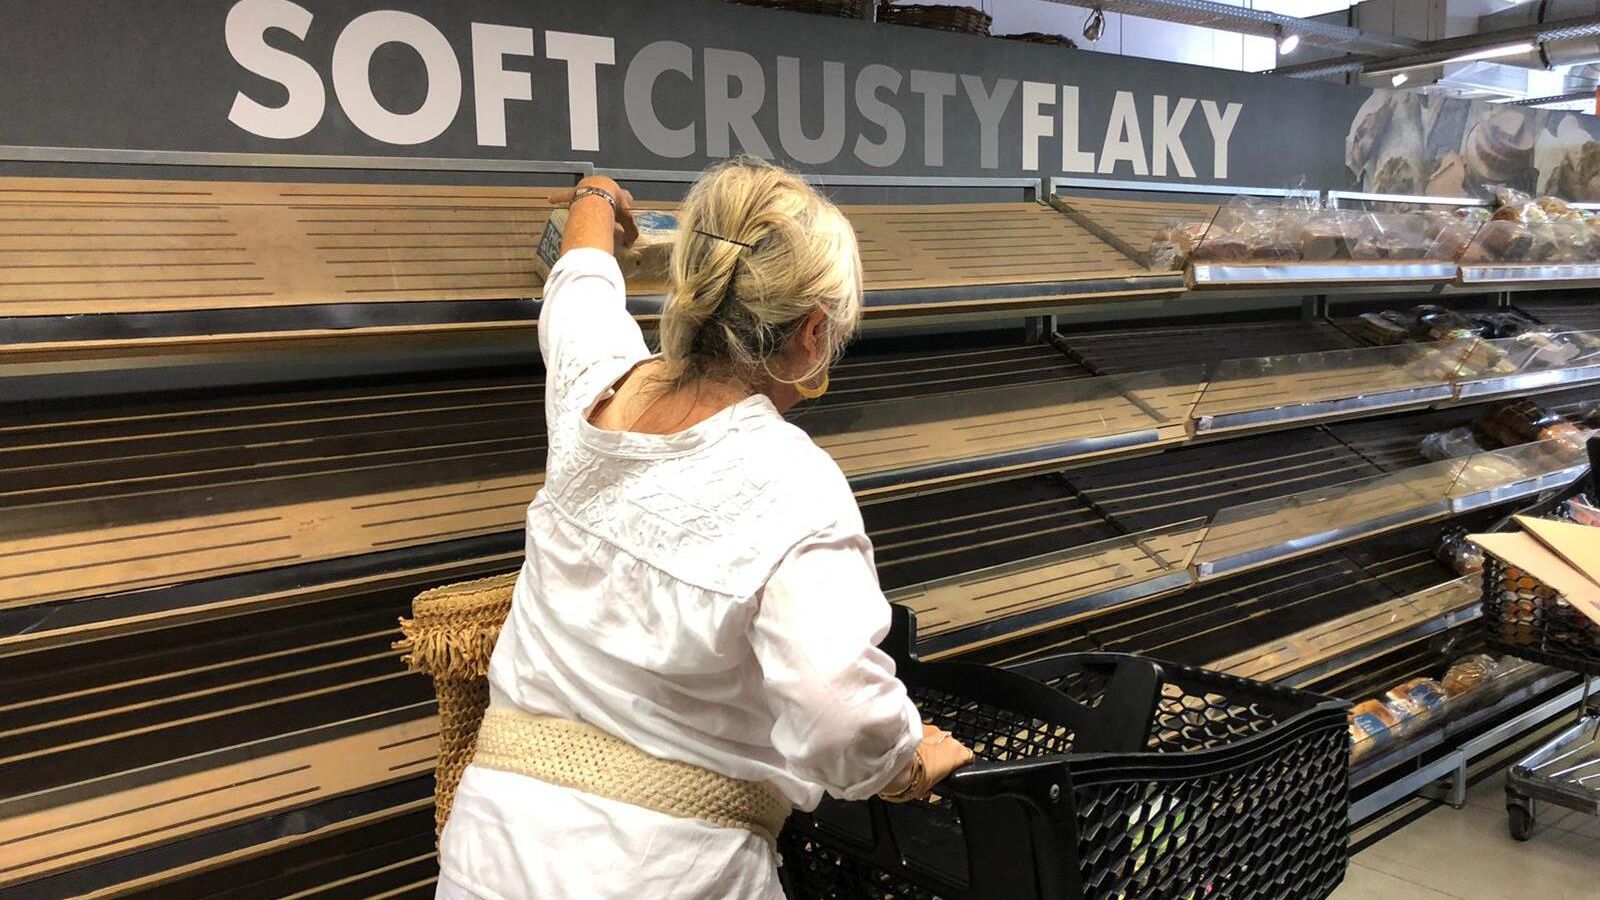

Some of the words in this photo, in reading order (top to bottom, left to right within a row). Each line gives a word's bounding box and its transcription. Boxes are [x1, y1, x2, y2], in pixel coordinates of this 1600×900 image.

[224, 0, 615, 151] SOFT
[624, 40, 1020, 168] CRUSTY
[1022, 81, 1243, 178] FLAKY
